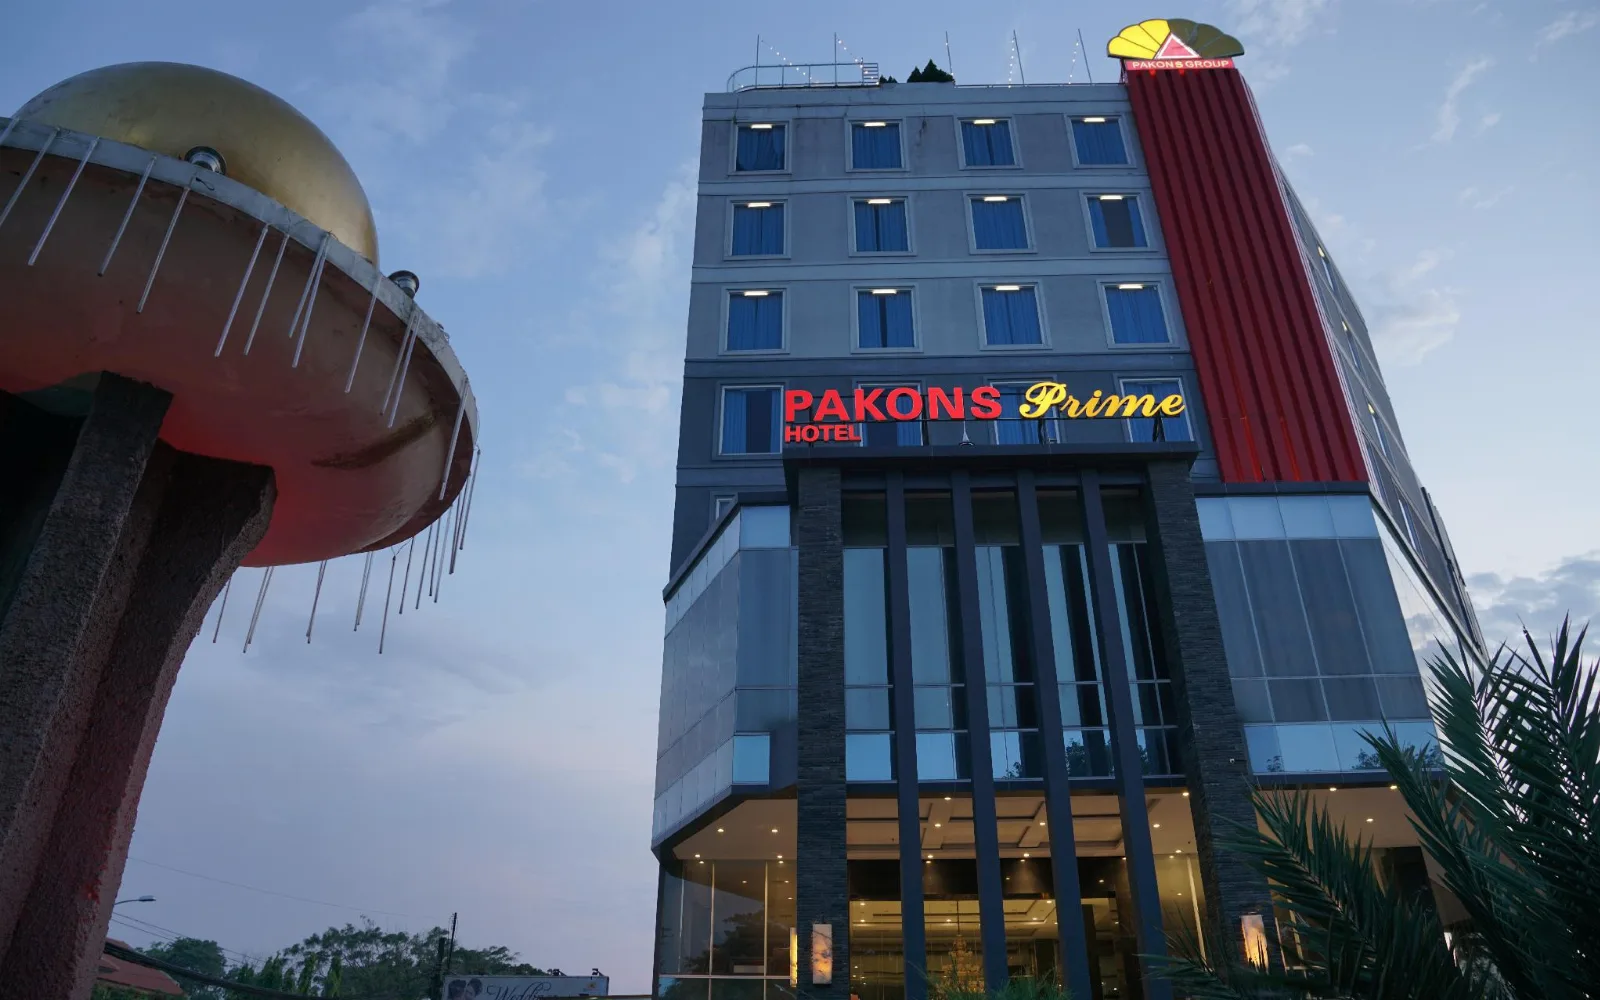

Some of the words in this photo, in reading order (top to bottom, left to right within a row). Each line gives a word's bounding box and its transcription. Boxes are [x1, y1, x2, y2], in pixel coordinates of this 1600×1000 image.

[1132, 61, 1182, 69] PAKONS
[1185, 60, 1229, 68] GROUP
[785, 387, 1002, 421] PAKONS
[1019, 381, 1185, 418] Prime
[785, 424, 861, 442] HOTEL
